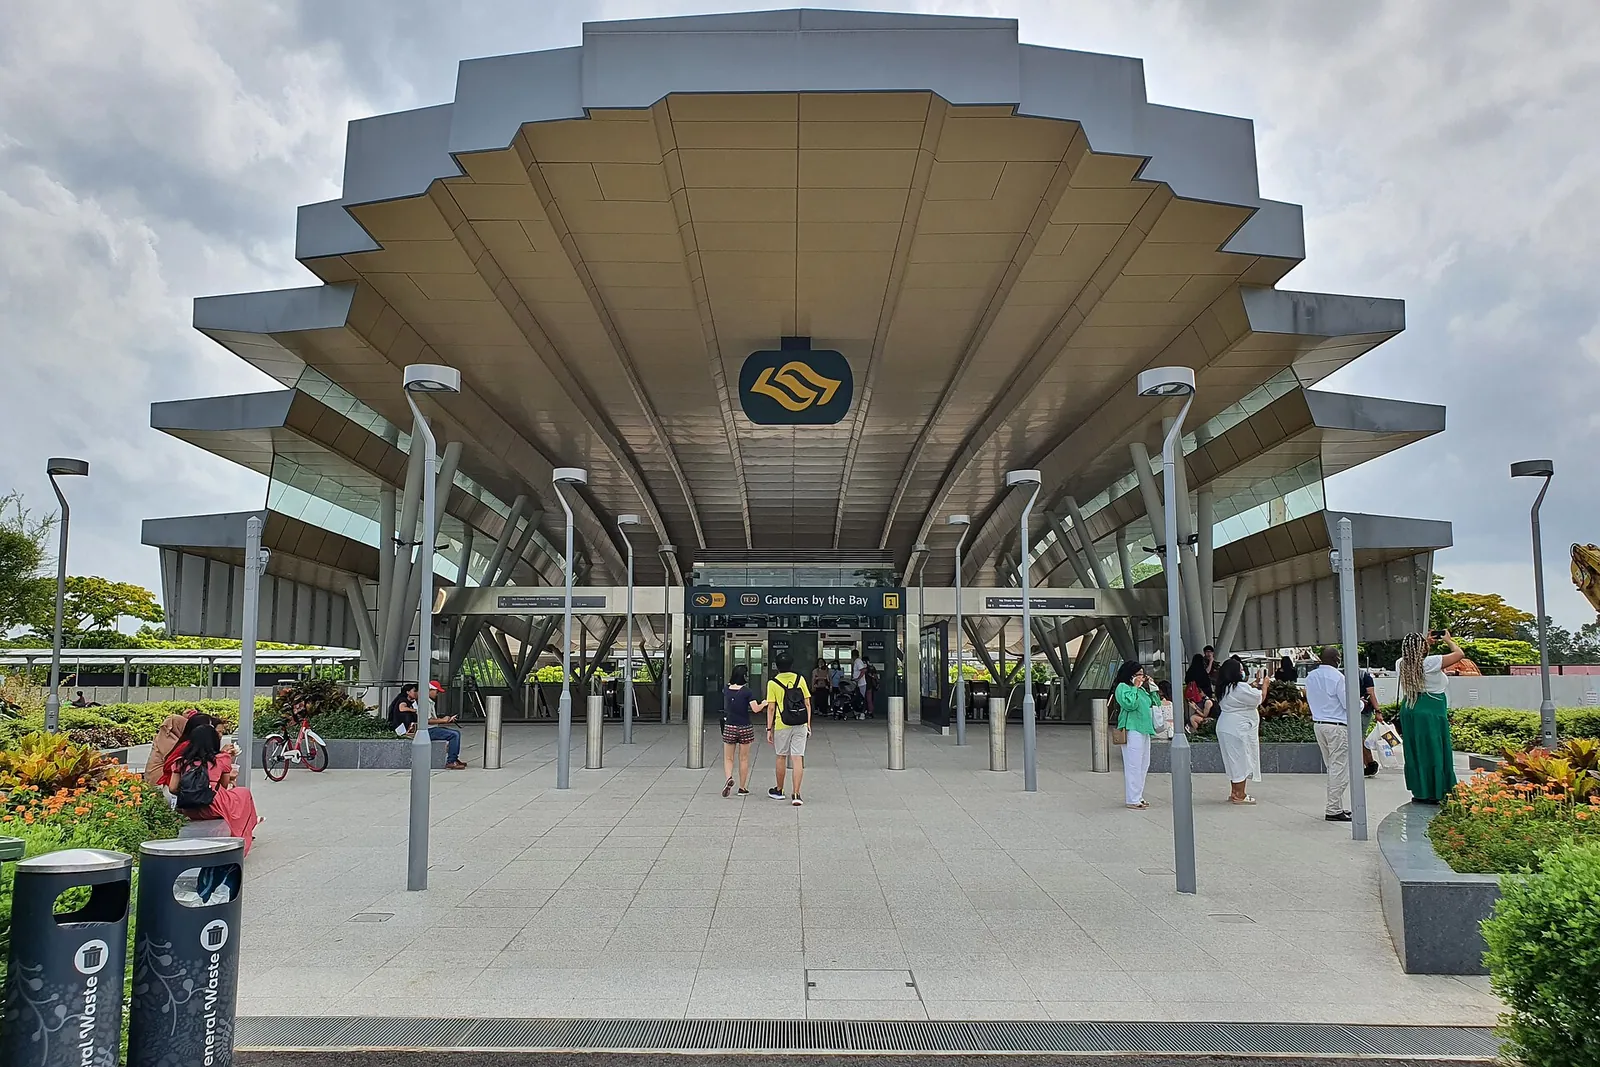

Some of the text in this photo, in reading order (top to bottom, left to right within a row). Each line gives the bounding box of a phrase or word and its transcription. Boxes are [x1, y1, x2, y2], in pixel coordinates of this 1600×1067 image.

[765, 594, 868, 607] Gardens by the Bay
[79, 976, 98, 1039] Waste
[203, 953, 220, 1067] eneral Waste
